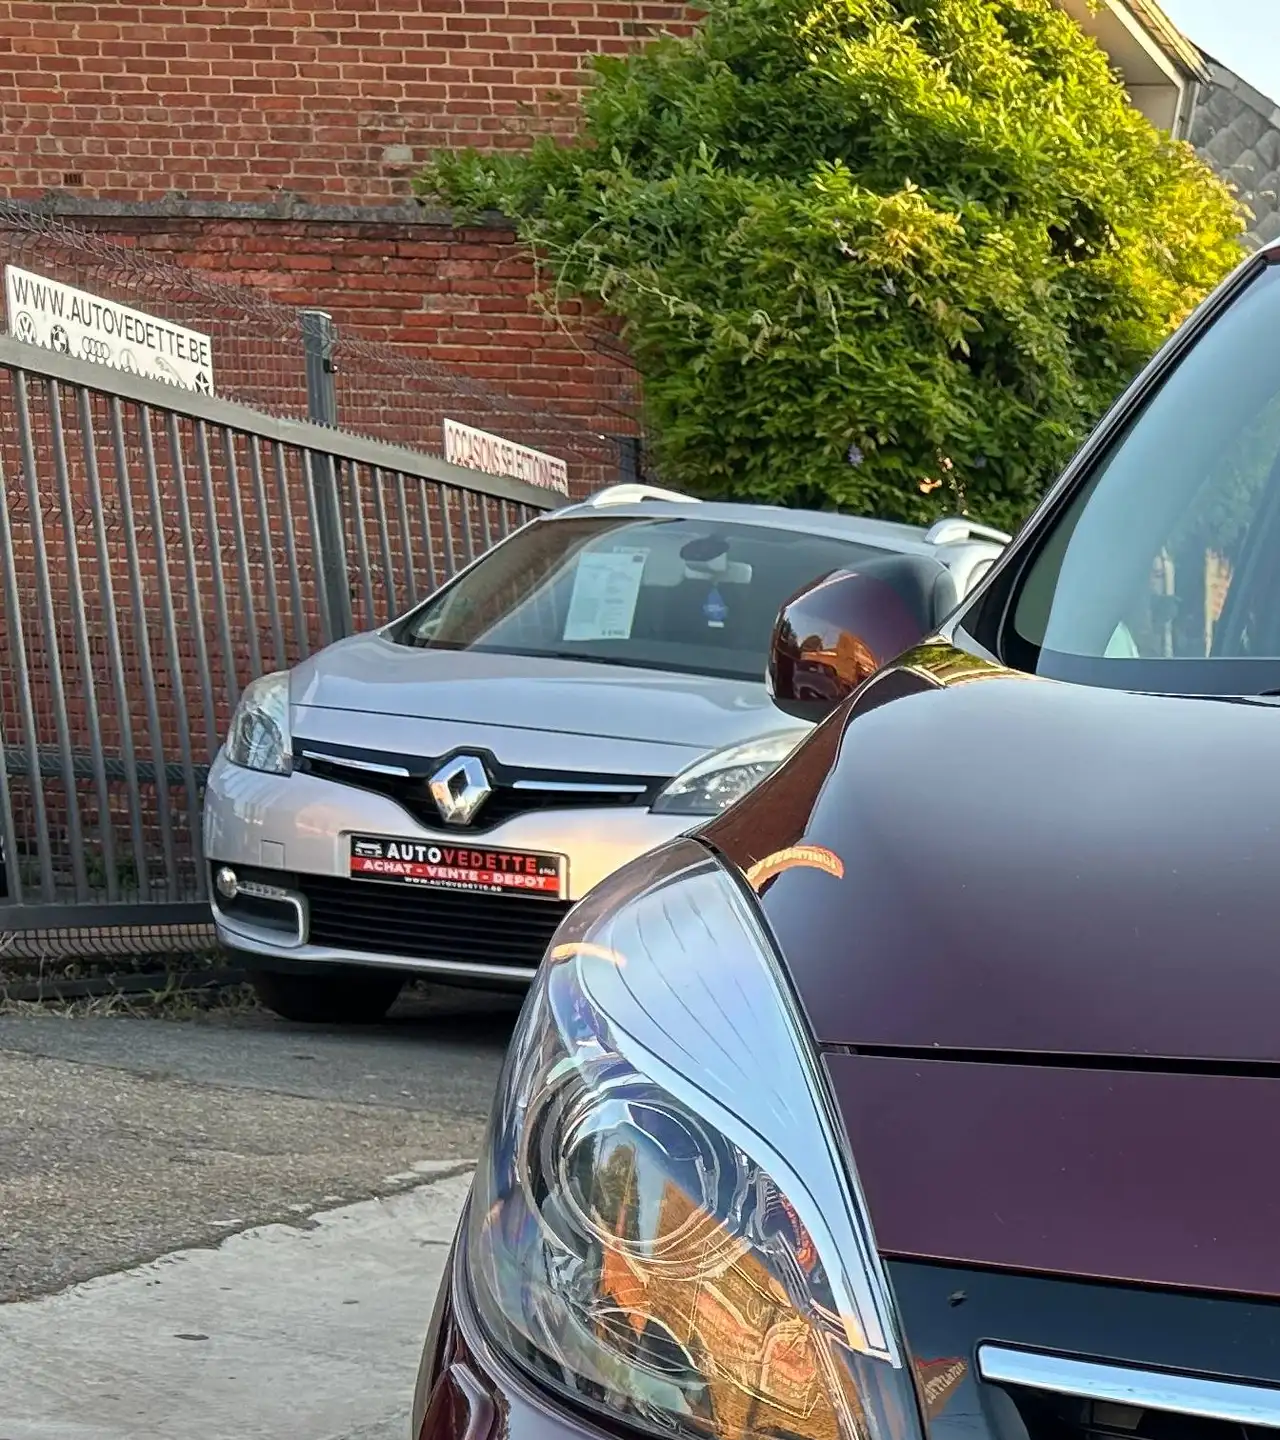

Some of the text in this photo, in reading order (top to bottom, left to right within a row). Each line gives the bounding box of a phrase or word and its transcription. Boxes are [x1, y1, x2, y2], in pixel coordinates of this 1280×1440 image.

[12, 273, 209, 367] WWW.AUTOVEDETTE.BE
[386, 843, 537, 873] AUTOVEDETTE
[362, 859, 413, 874] ACHAT
[426, 866, 478, 881] VENTE
[493, 873, 547, 888] DEPOT
